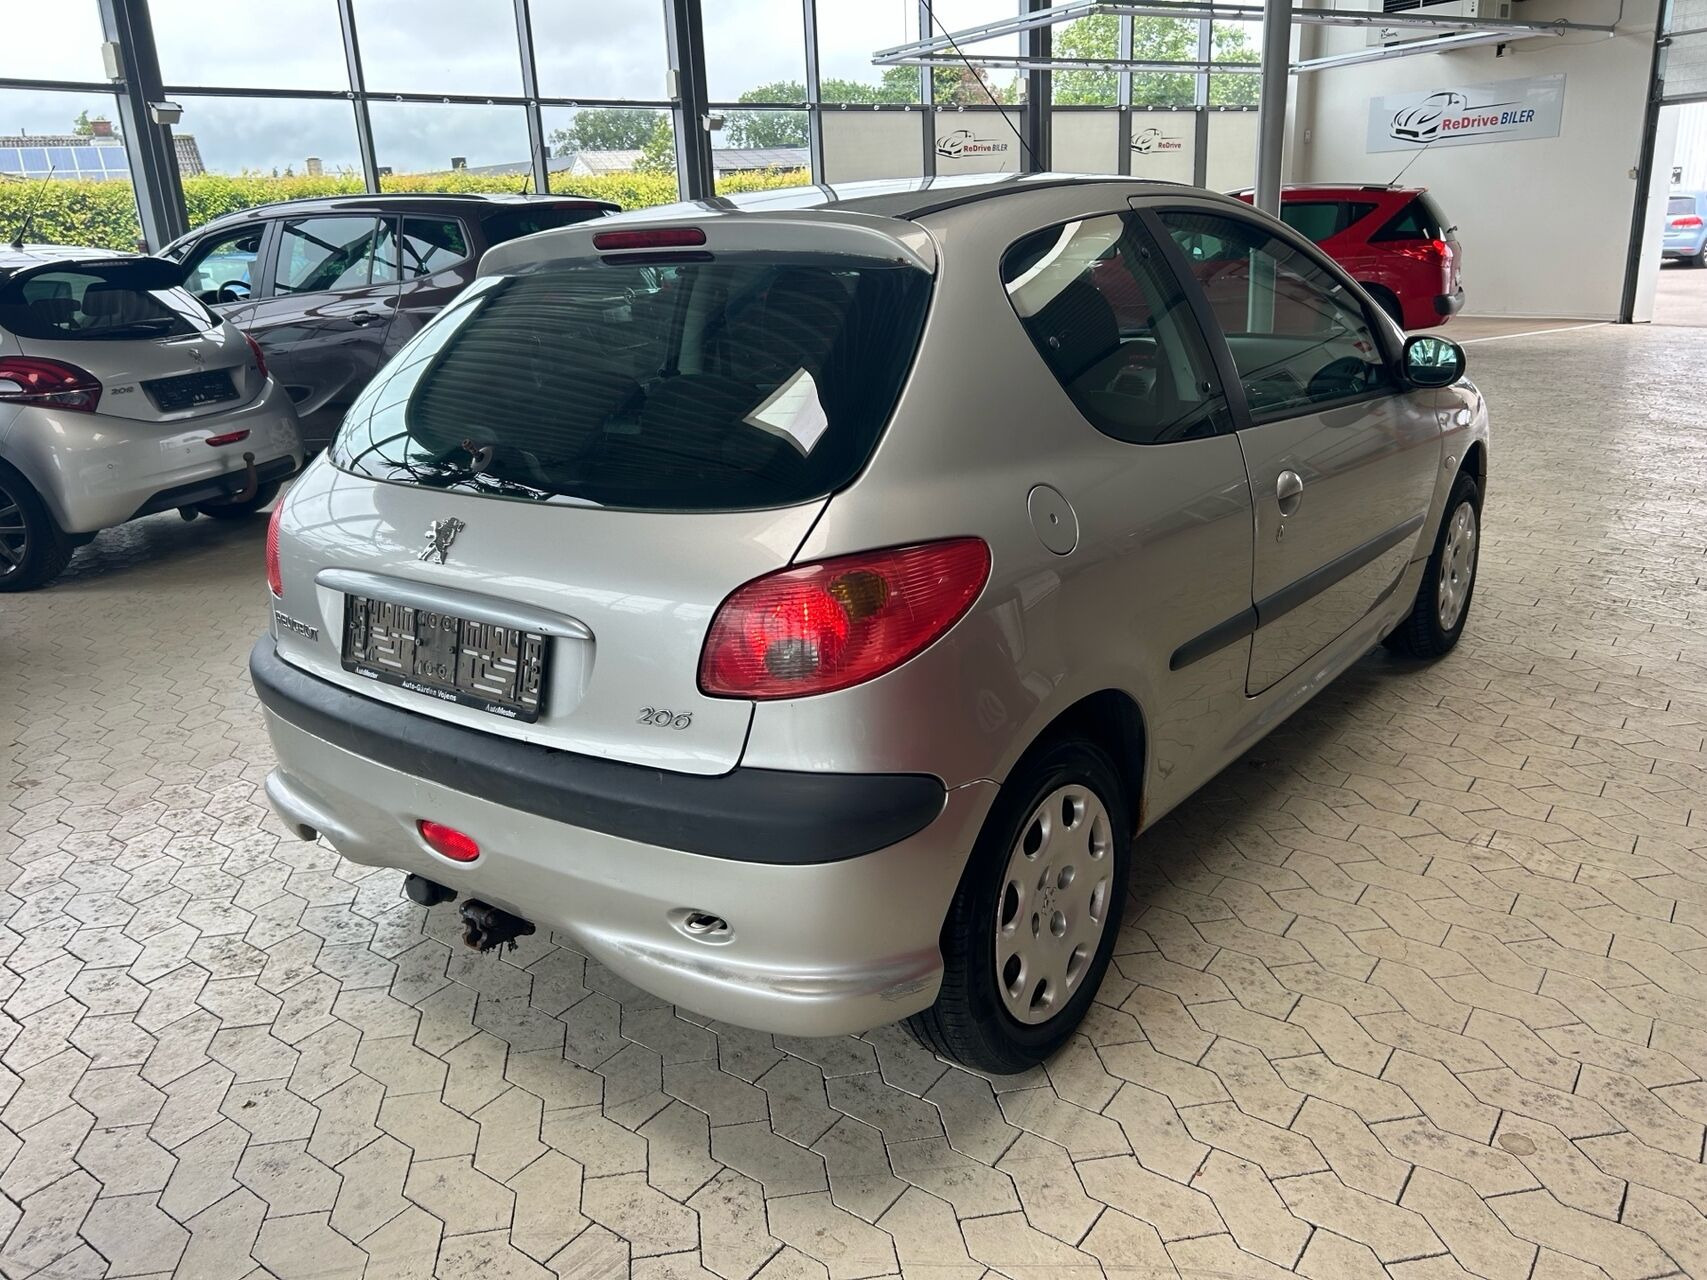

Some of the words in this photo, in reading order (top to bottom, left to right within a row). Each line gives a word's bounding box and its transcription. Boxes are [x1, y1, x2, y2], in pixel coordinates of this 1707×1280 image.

[1442, 115, 1499, 131] ReDrive
[1500, 109, 1535, 125] BILER
[992, 143, 1008, 152] BILER
[1157, 141, 1182, 149] ReDrive
[636, 705, 693, 731] 206
